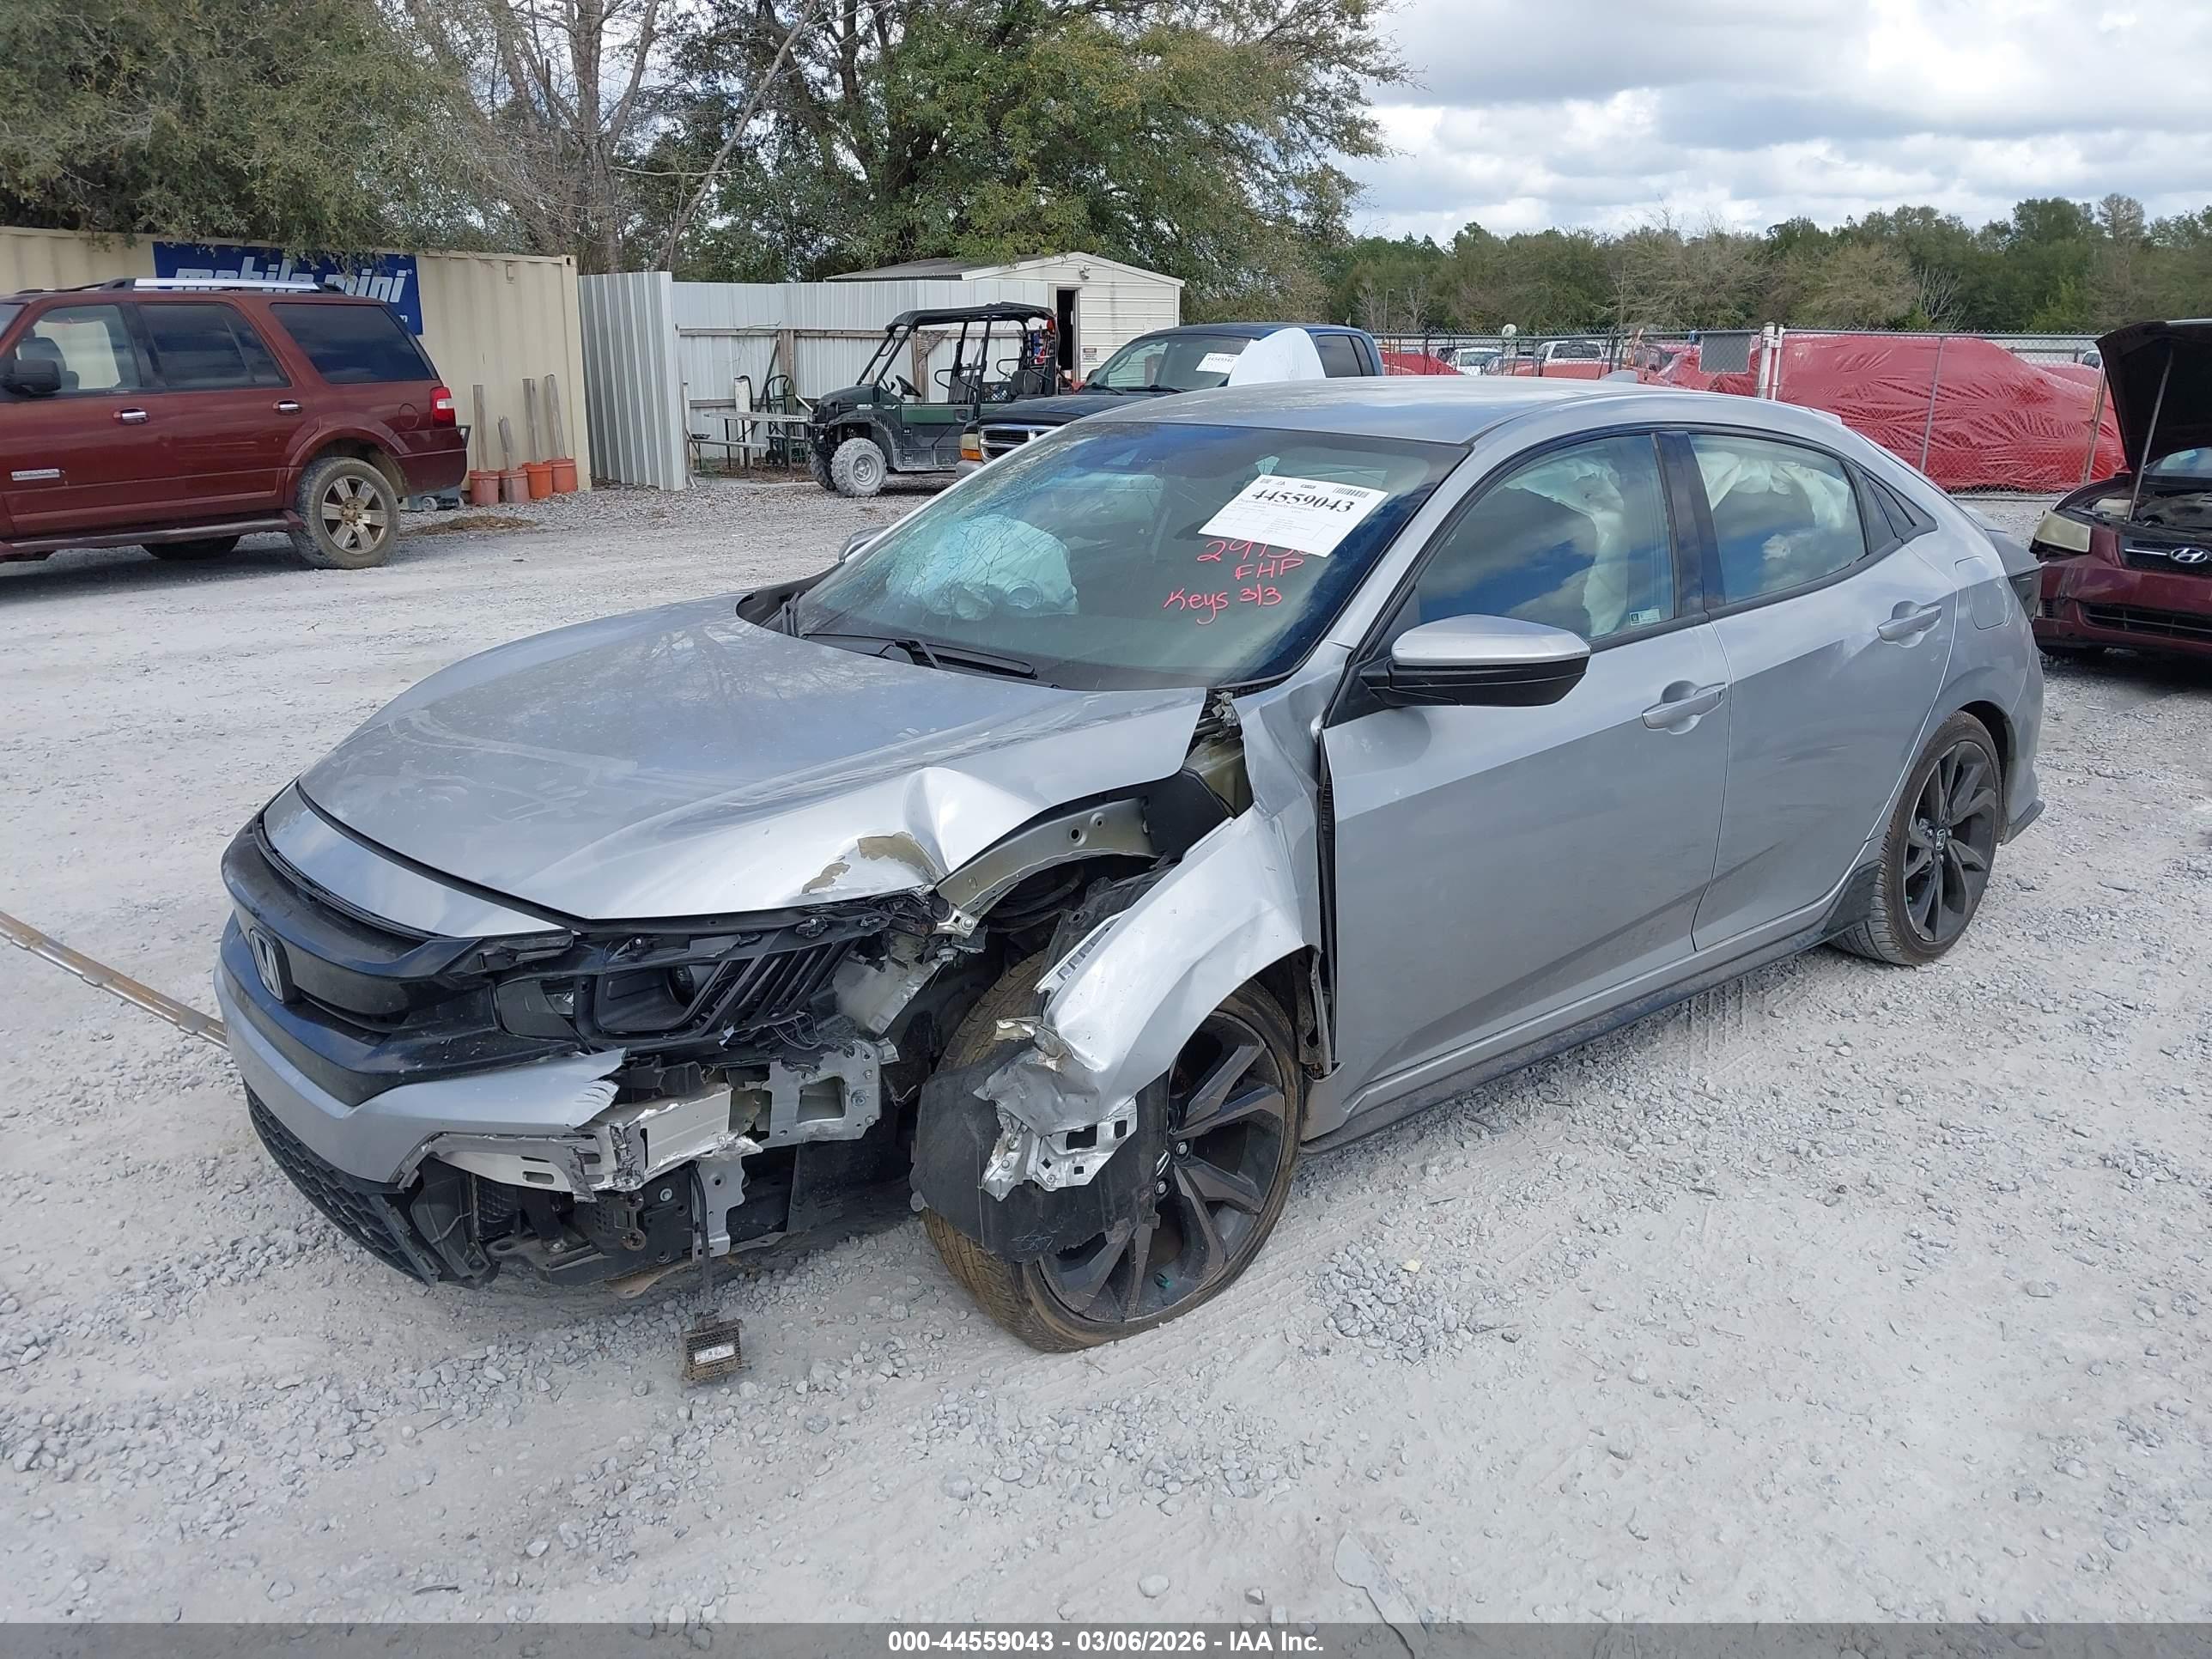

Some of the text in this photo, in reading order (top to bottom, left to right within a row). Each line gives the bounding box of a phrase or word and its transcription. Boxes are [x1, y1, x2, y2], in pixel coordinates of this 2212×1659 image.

[325, 268, 407, 303] mini
[1251, 489, 1355, 513] 44559043
[1235, 558, 1304, 580] FHP
[1163, 587, 1229, 625] Keys
